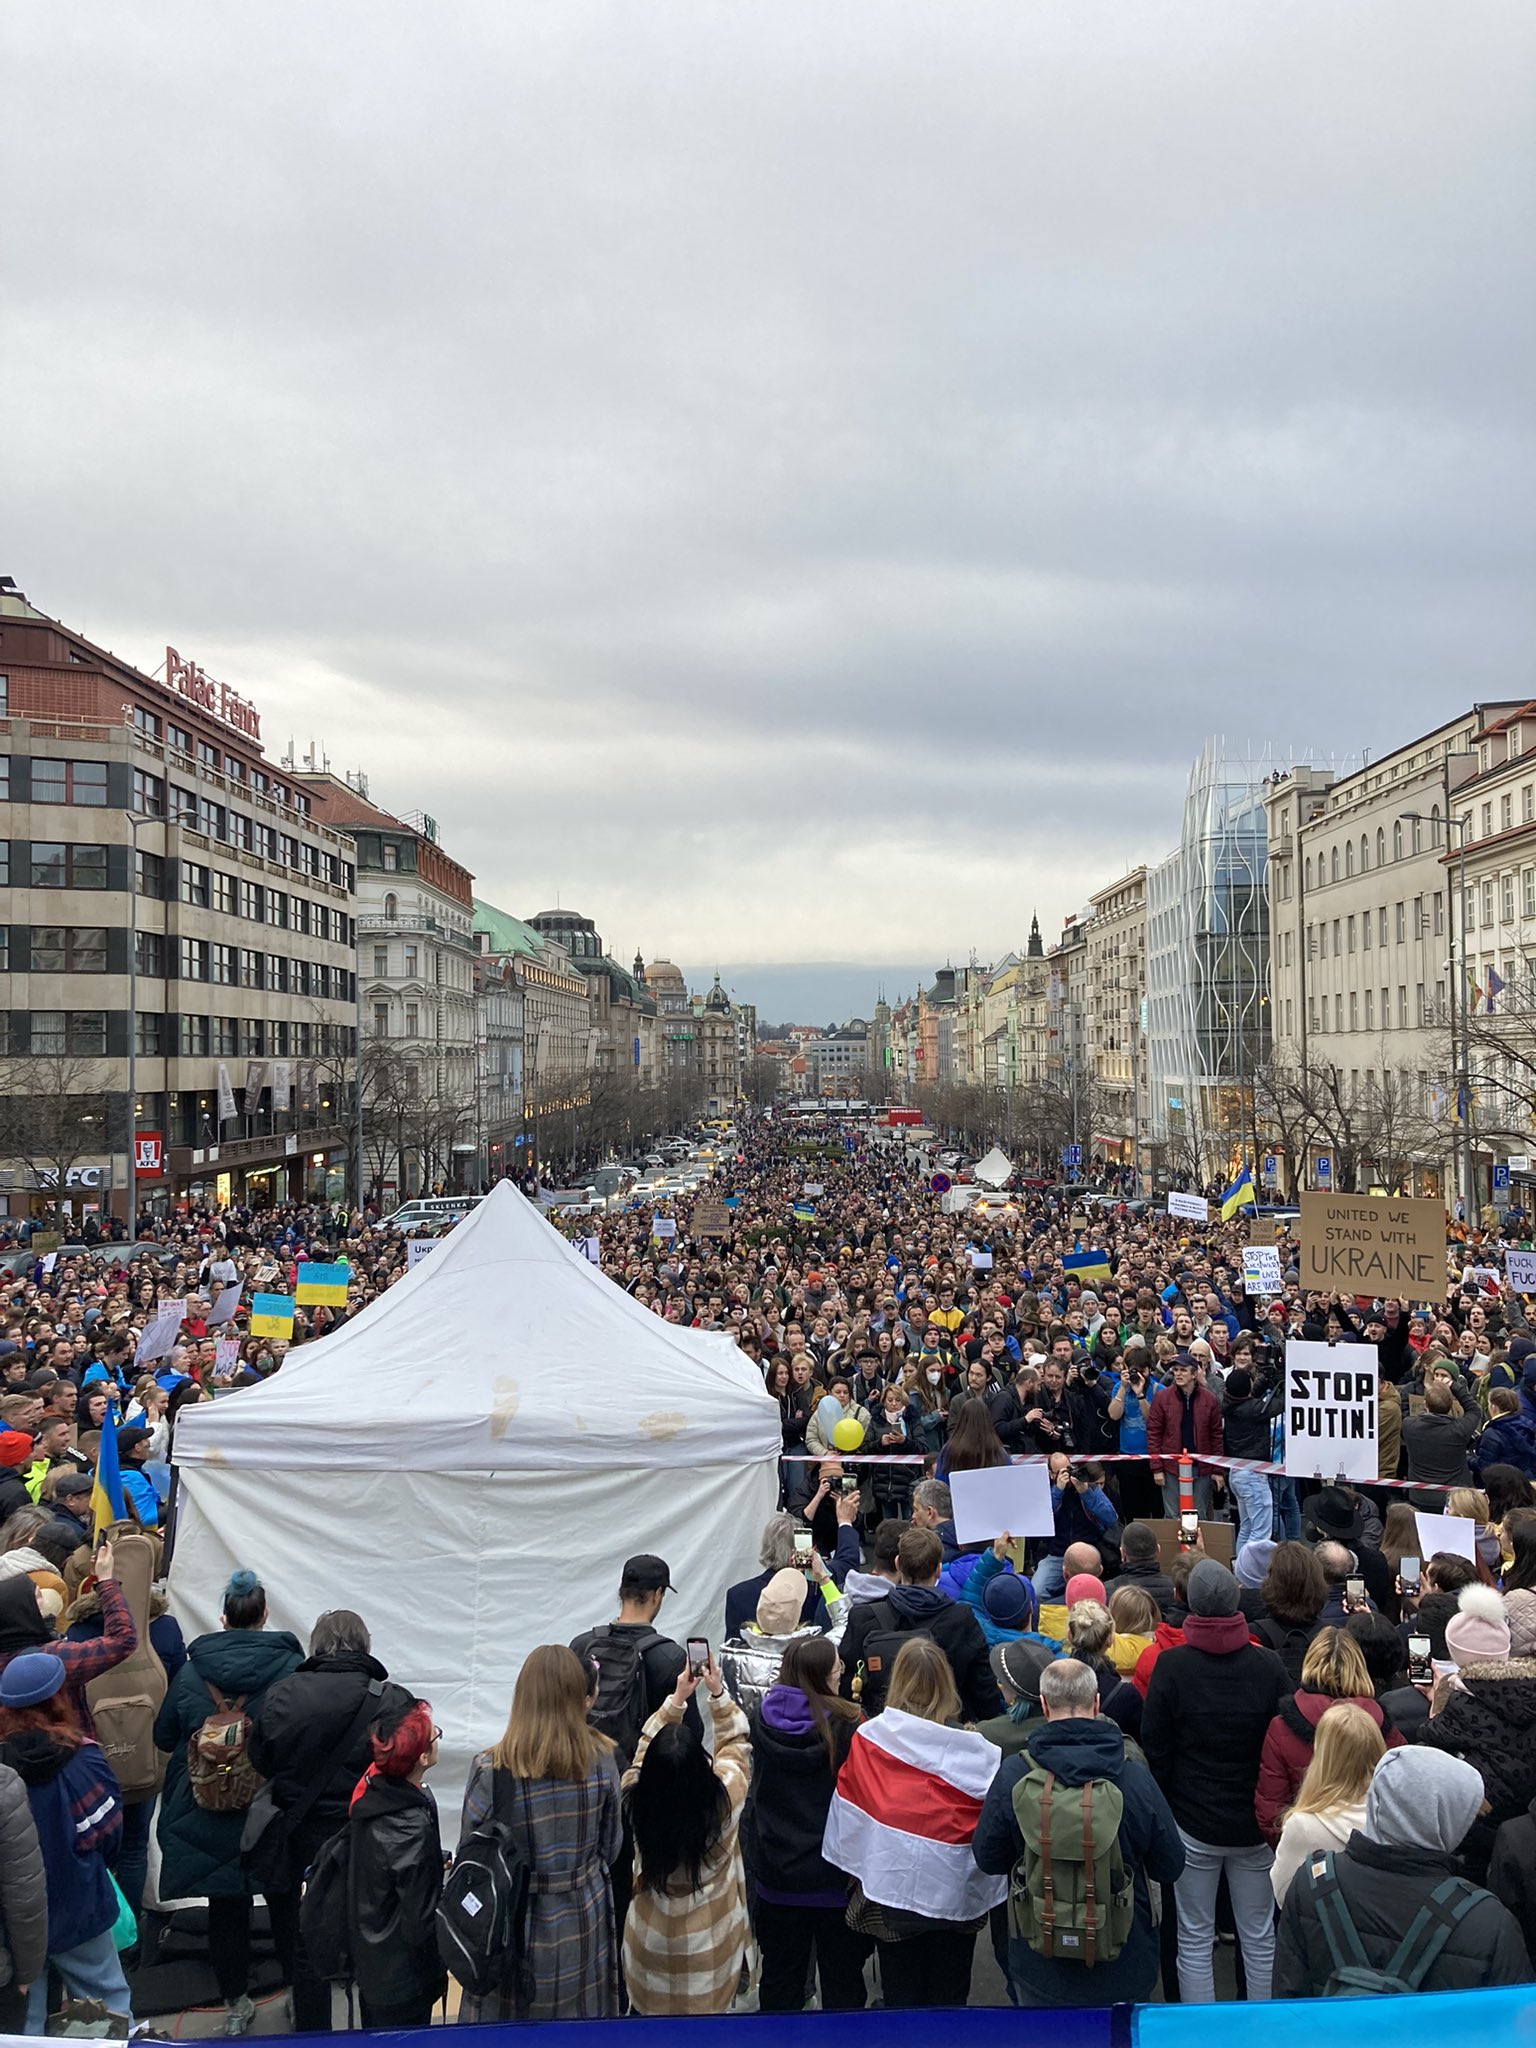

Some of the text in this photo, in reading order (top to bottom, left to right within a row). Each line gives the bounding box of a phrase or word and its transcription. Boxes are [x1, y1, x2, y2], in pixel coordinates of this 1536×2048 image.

[166, 646, 260, 740] Palác Fénix
[40, 1168, 100, 1188] KFC
[1496, 1168, 1507, 1181] P
[430, 1202, 467, 1210] SKLENKA
[1327, 1209, 1410, 1224] UNITED WE
[1326, 1227, 1416, 1245] STAND WITH
[1245, 1251, 1277, 1262] STOP THE
[1312, 1245, 1435, 1283] UKRAINE
[1508, 1257, 1533, 1269] FUCK
[1262, 1270, 1279, 1279] LIVES
[1512, 1271, 1536, 1284] FUC
[1247, 1281, 1262, 1291] ARE
[1290, 1369, 1374, 1402] STOP
[1291, 1400, 1374, 1439] PUTIN!
[104, 1742, 137, 1757] Taylor
